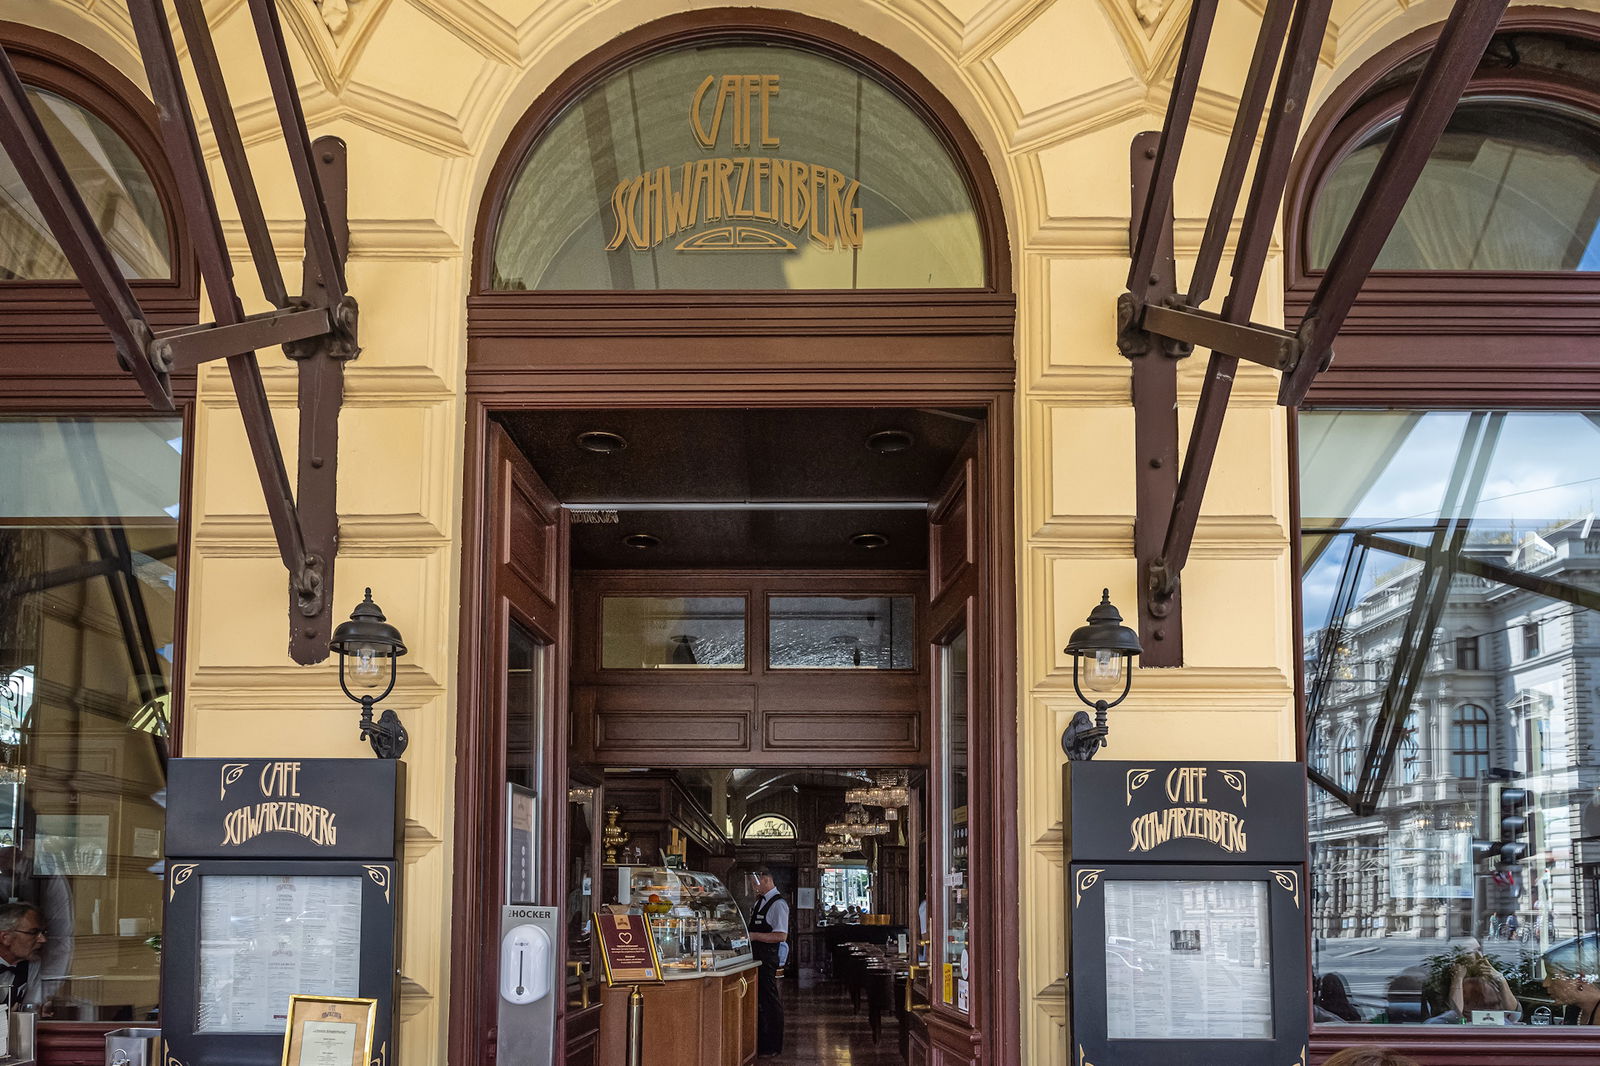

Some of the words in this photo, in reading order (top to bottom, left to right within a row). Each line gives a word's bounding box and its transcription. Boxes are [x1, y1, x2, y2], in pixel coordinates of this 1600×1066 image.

[690, 75, 781, 149] CAFE
[605, 157, 863, 250] SCHWARZENBERG
[260, 762, 301, 797] CAFE
[1166, 767, 1208, 803] CAFE
[221, 802, 337, 846] SCHWARZENBERG
[1129, 808, 1247, 853] SCHWARZENBERG
